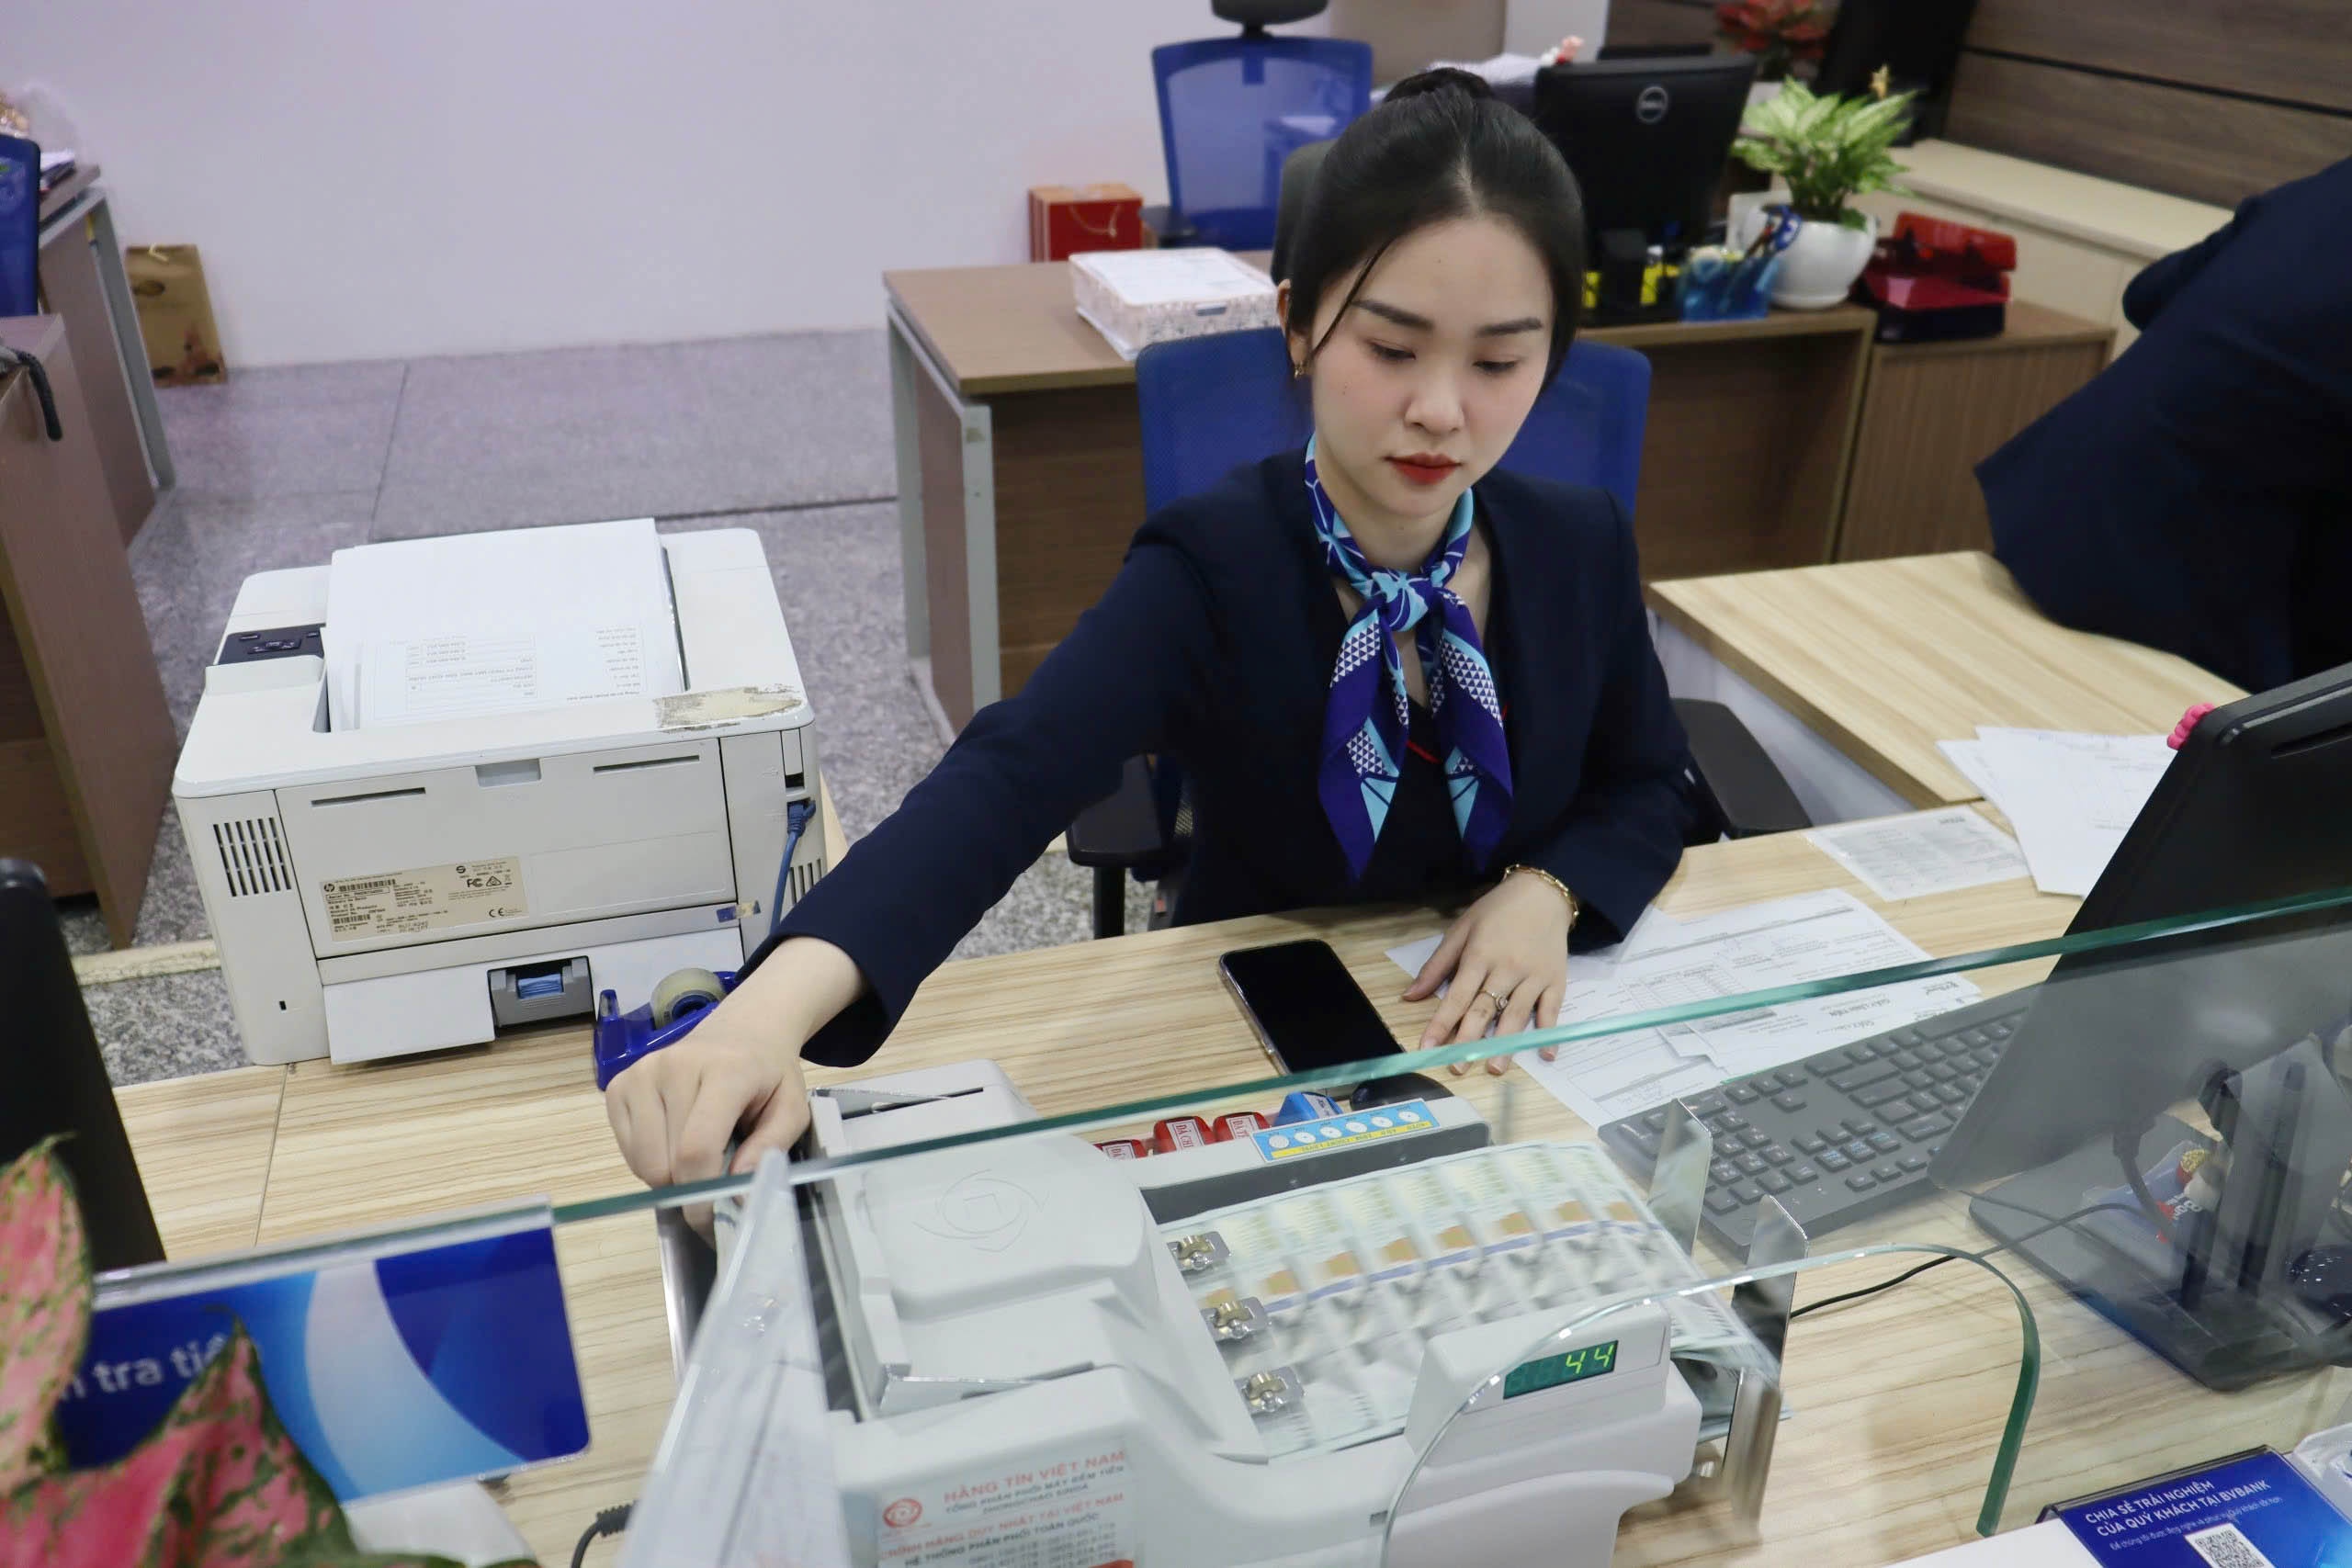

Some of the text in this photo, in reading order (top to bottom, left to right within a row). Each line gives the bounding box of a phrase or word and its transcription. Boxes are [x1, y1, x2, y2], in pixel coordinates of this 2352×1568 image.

[93, 1358, 163, 1393] tra
[1565, 1344, 1614, 1374] 44
[1085, 1450, 1125, 1469] NAM
[2085, 1506, 2118, 1524] CHIA
[2163, 1480, 2215, 1502] NGHIỆM
[2097, 1479, 2272, 1537] CỦA QUÝ KHÁCH TẠI BVBANK
